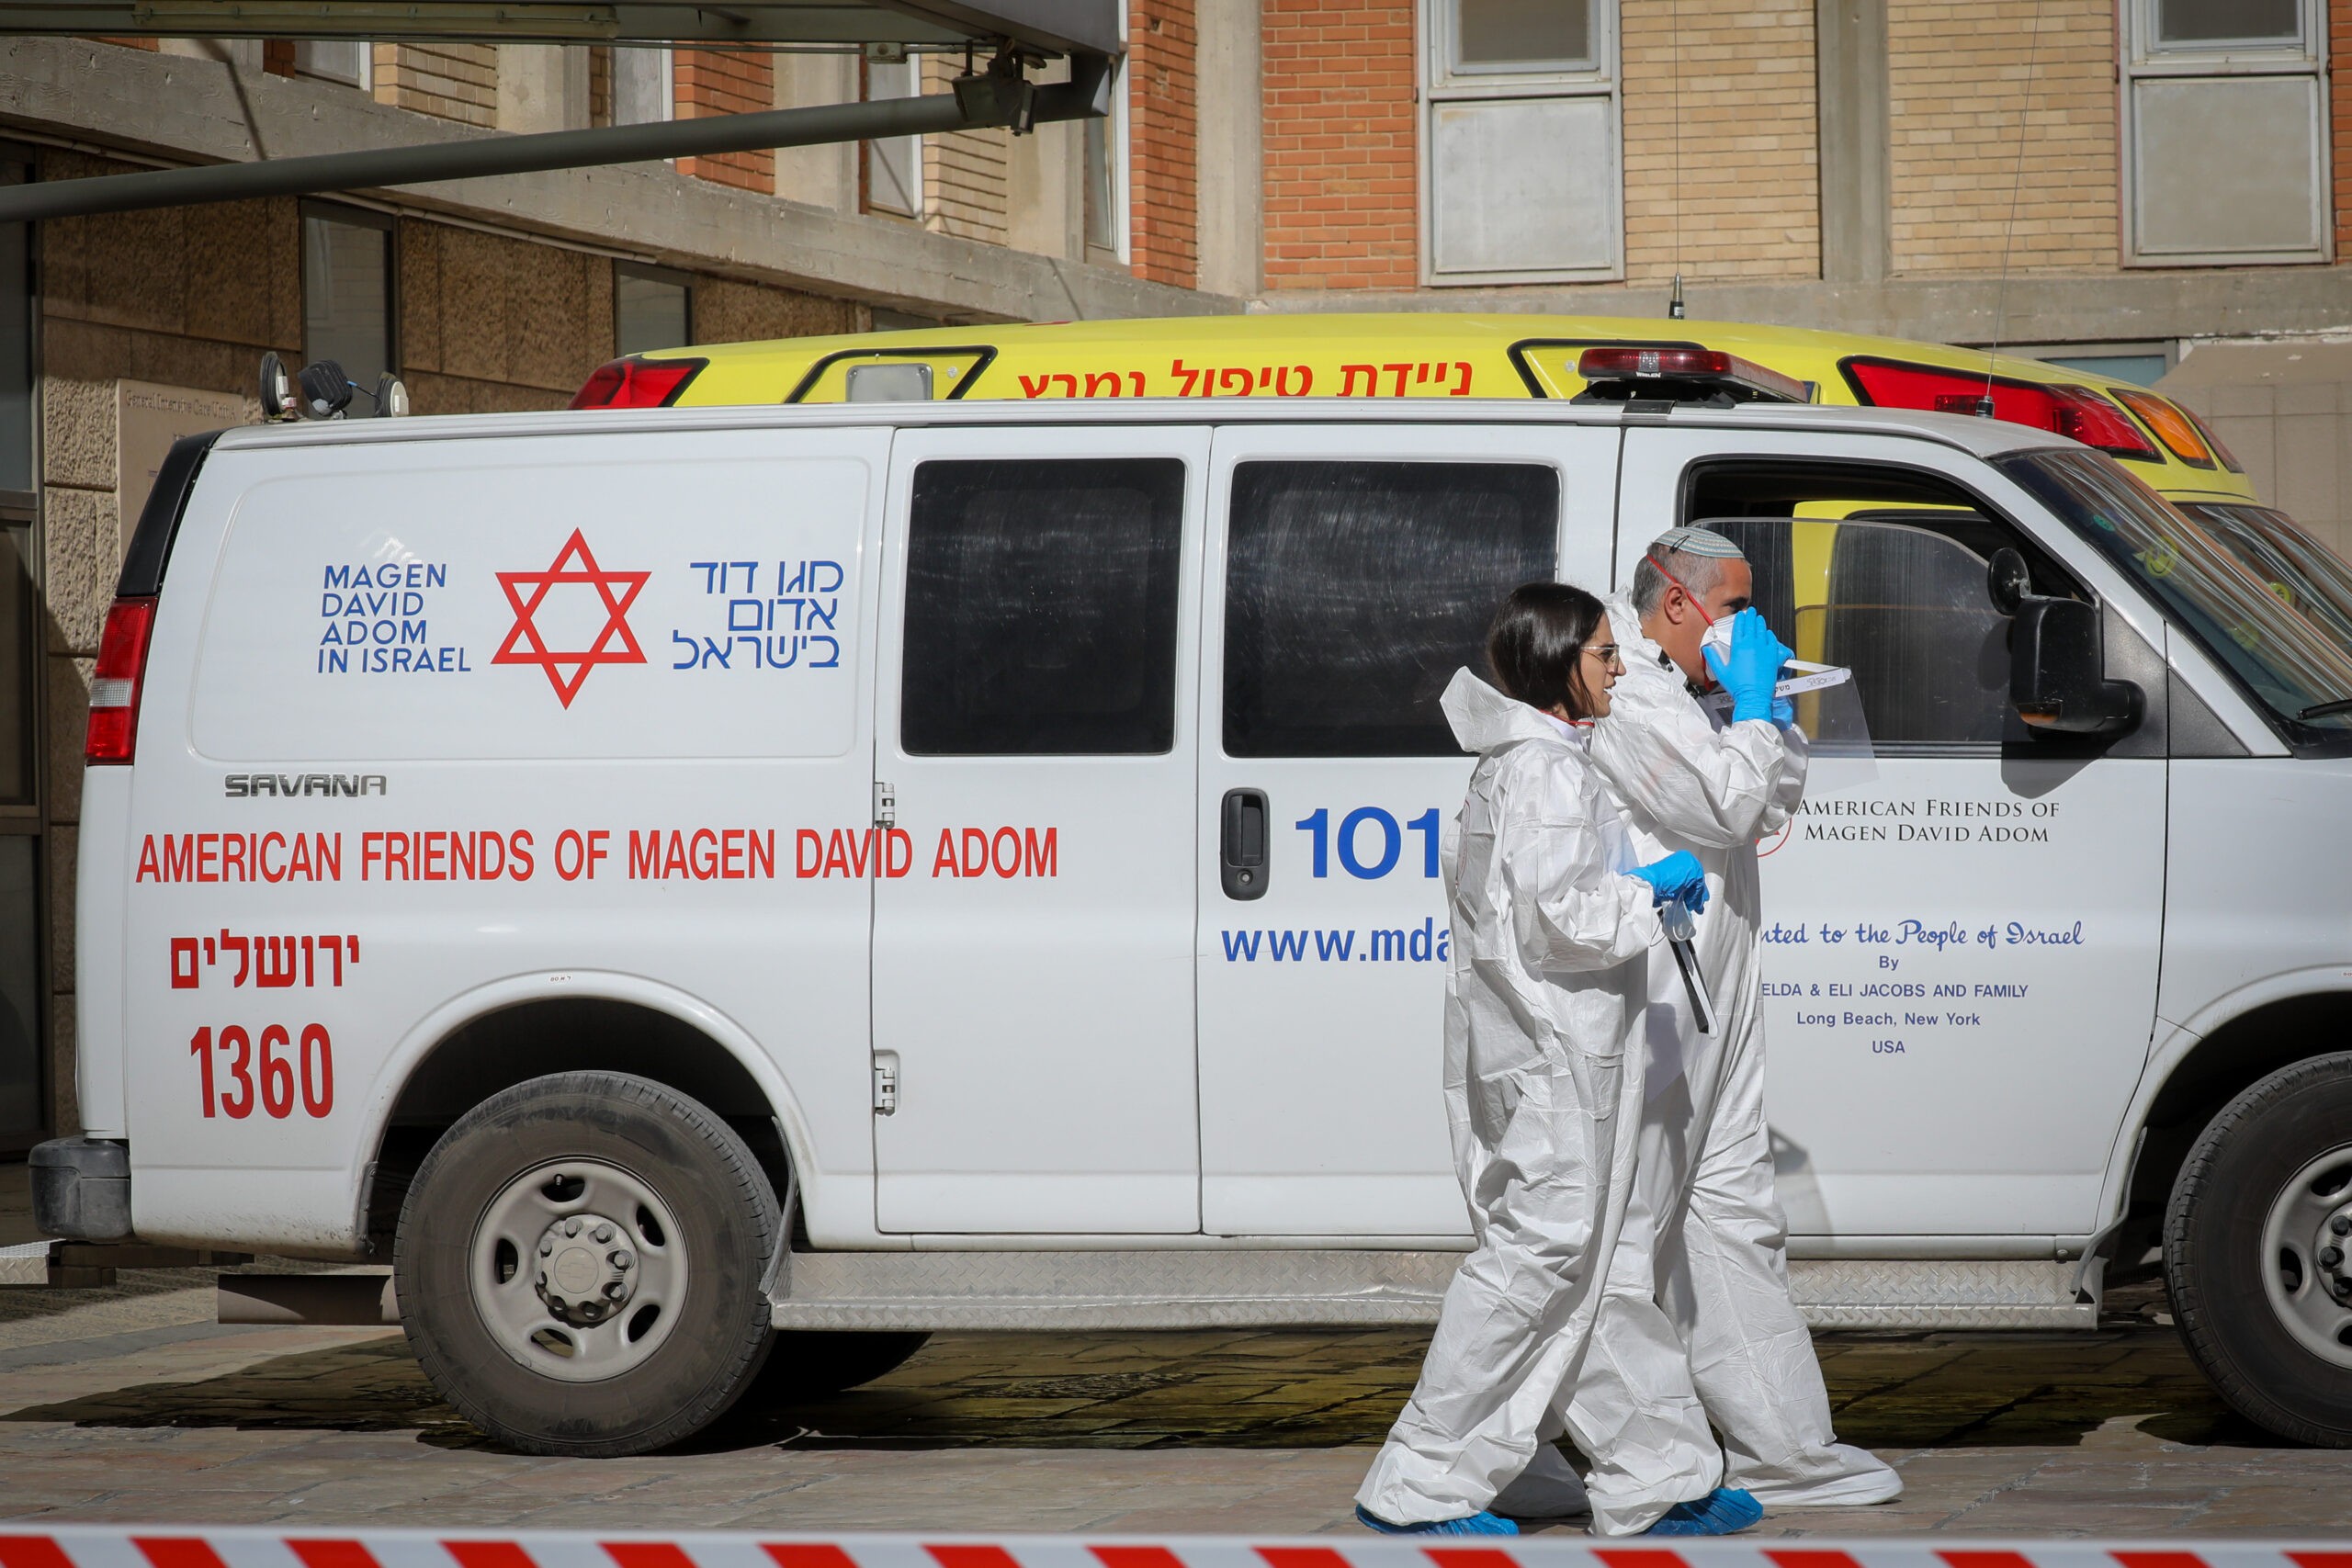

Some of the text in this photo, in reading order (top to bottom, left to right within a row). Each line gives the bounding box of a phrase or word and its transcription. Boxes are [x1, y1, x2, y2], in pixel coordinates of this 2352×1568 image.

[1018, 359, 1473, 399] ניידת טיפול נמרץ
[125, 389, 156, 410] General
[157, 393, 192, 414] Intensive
[194, 399, 211, 417] Care
[323, 563, 447, 589] MAGEN
[690, 560, 844, 596] מגן דוד
[322, 592, 424, 617] DAVID
[728, 598, 838, 631] אדום
[321, 620, 427, 646] ADOM
[318, 648, 471, 673] IN ISRAEL
[673, 630, 841, 670] בישראל
[224, 773, 387, 798] SAVANA
[1797, 797, 2060, 818] AMERICAN FRIENDS OF
[1295, 807, 1441, 880] 101
[1804, 823, 2050, 843] MAGEN DAVID ADOM
[136, 827, 1058, 884] AMERICAN FRIENDS OF MAGEN DAVID ADOM
[1819, 923, 1847, 944] to
[1855, 921, 1891, 944] the
[1895, 919, 1968, 952] People
[1977, 921, 1999, 950] of
[2006, 919, 2086, 946] Israel
[171, 929, 359, 989] ירושלים
[1879, 955, 1899, 971] By
[1810, 983, 1821, 997] &
[1828, 983, 1853, 998] ELI
[1860, 983, 1926, 998] JACOBS
[1933, 984, 1968, 998] AND
[1974, 984, 2029, 998] FAMILY
[1797, 1011, 1981, 1028] Long Beach, New York
[1872, 1040, 1905, 1055] USA
[190, 1022, 334, 1119] 1360
